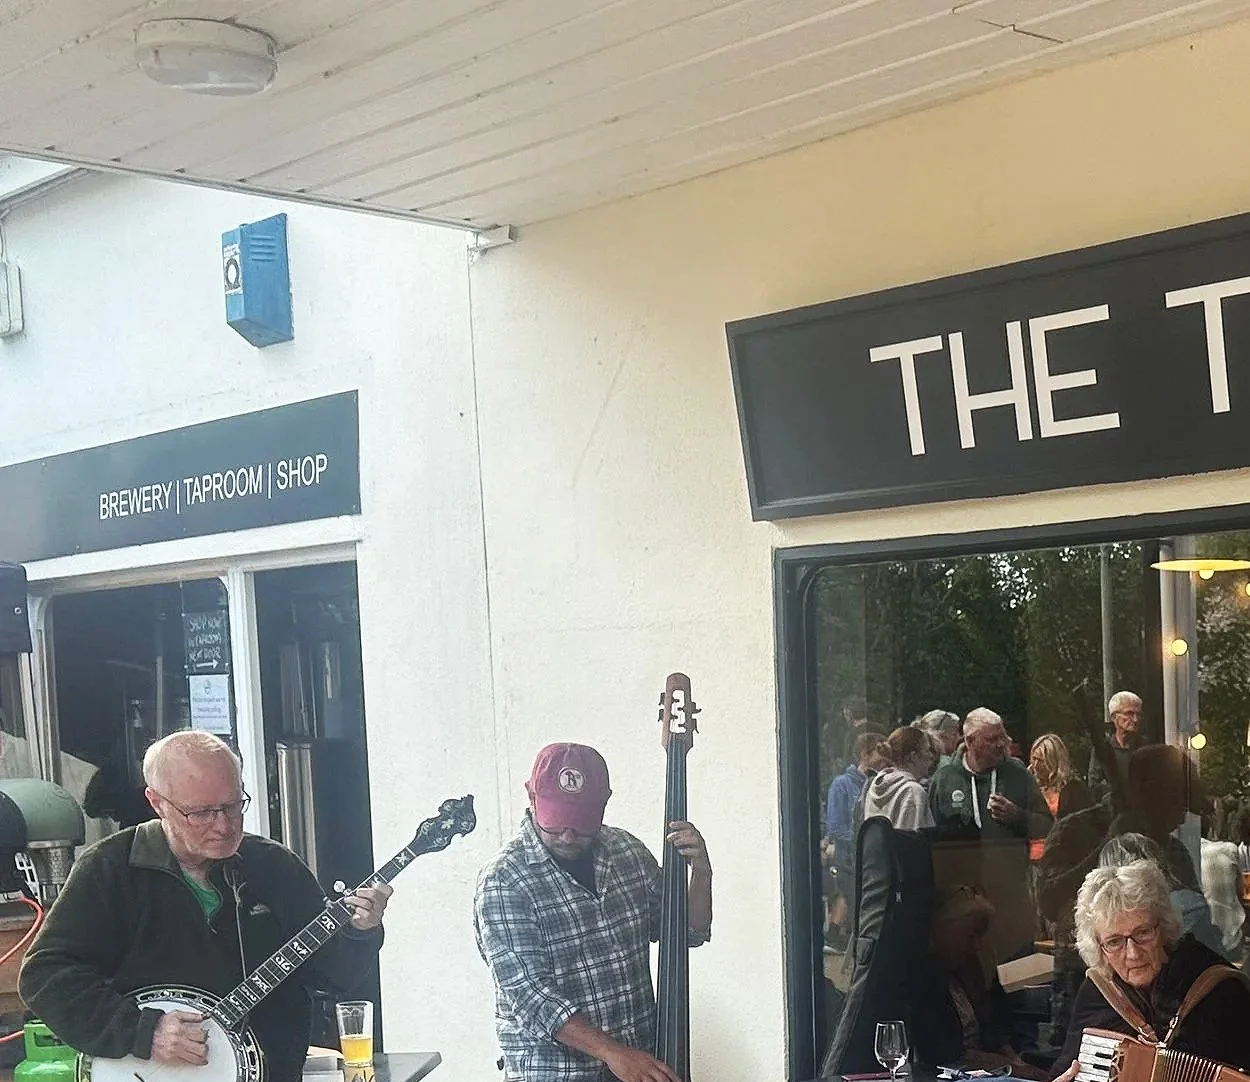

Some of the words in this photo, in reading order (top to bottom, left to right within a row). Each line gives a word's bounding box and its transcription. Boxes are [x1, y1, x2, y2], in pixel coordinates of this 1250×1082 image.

[869, 303, 1121, 457] THE
[99, 479, 173, 520] BREWERY
[183, 464, 263, 505] TAPROOM
[276, 453, 328, 490] SHOP
